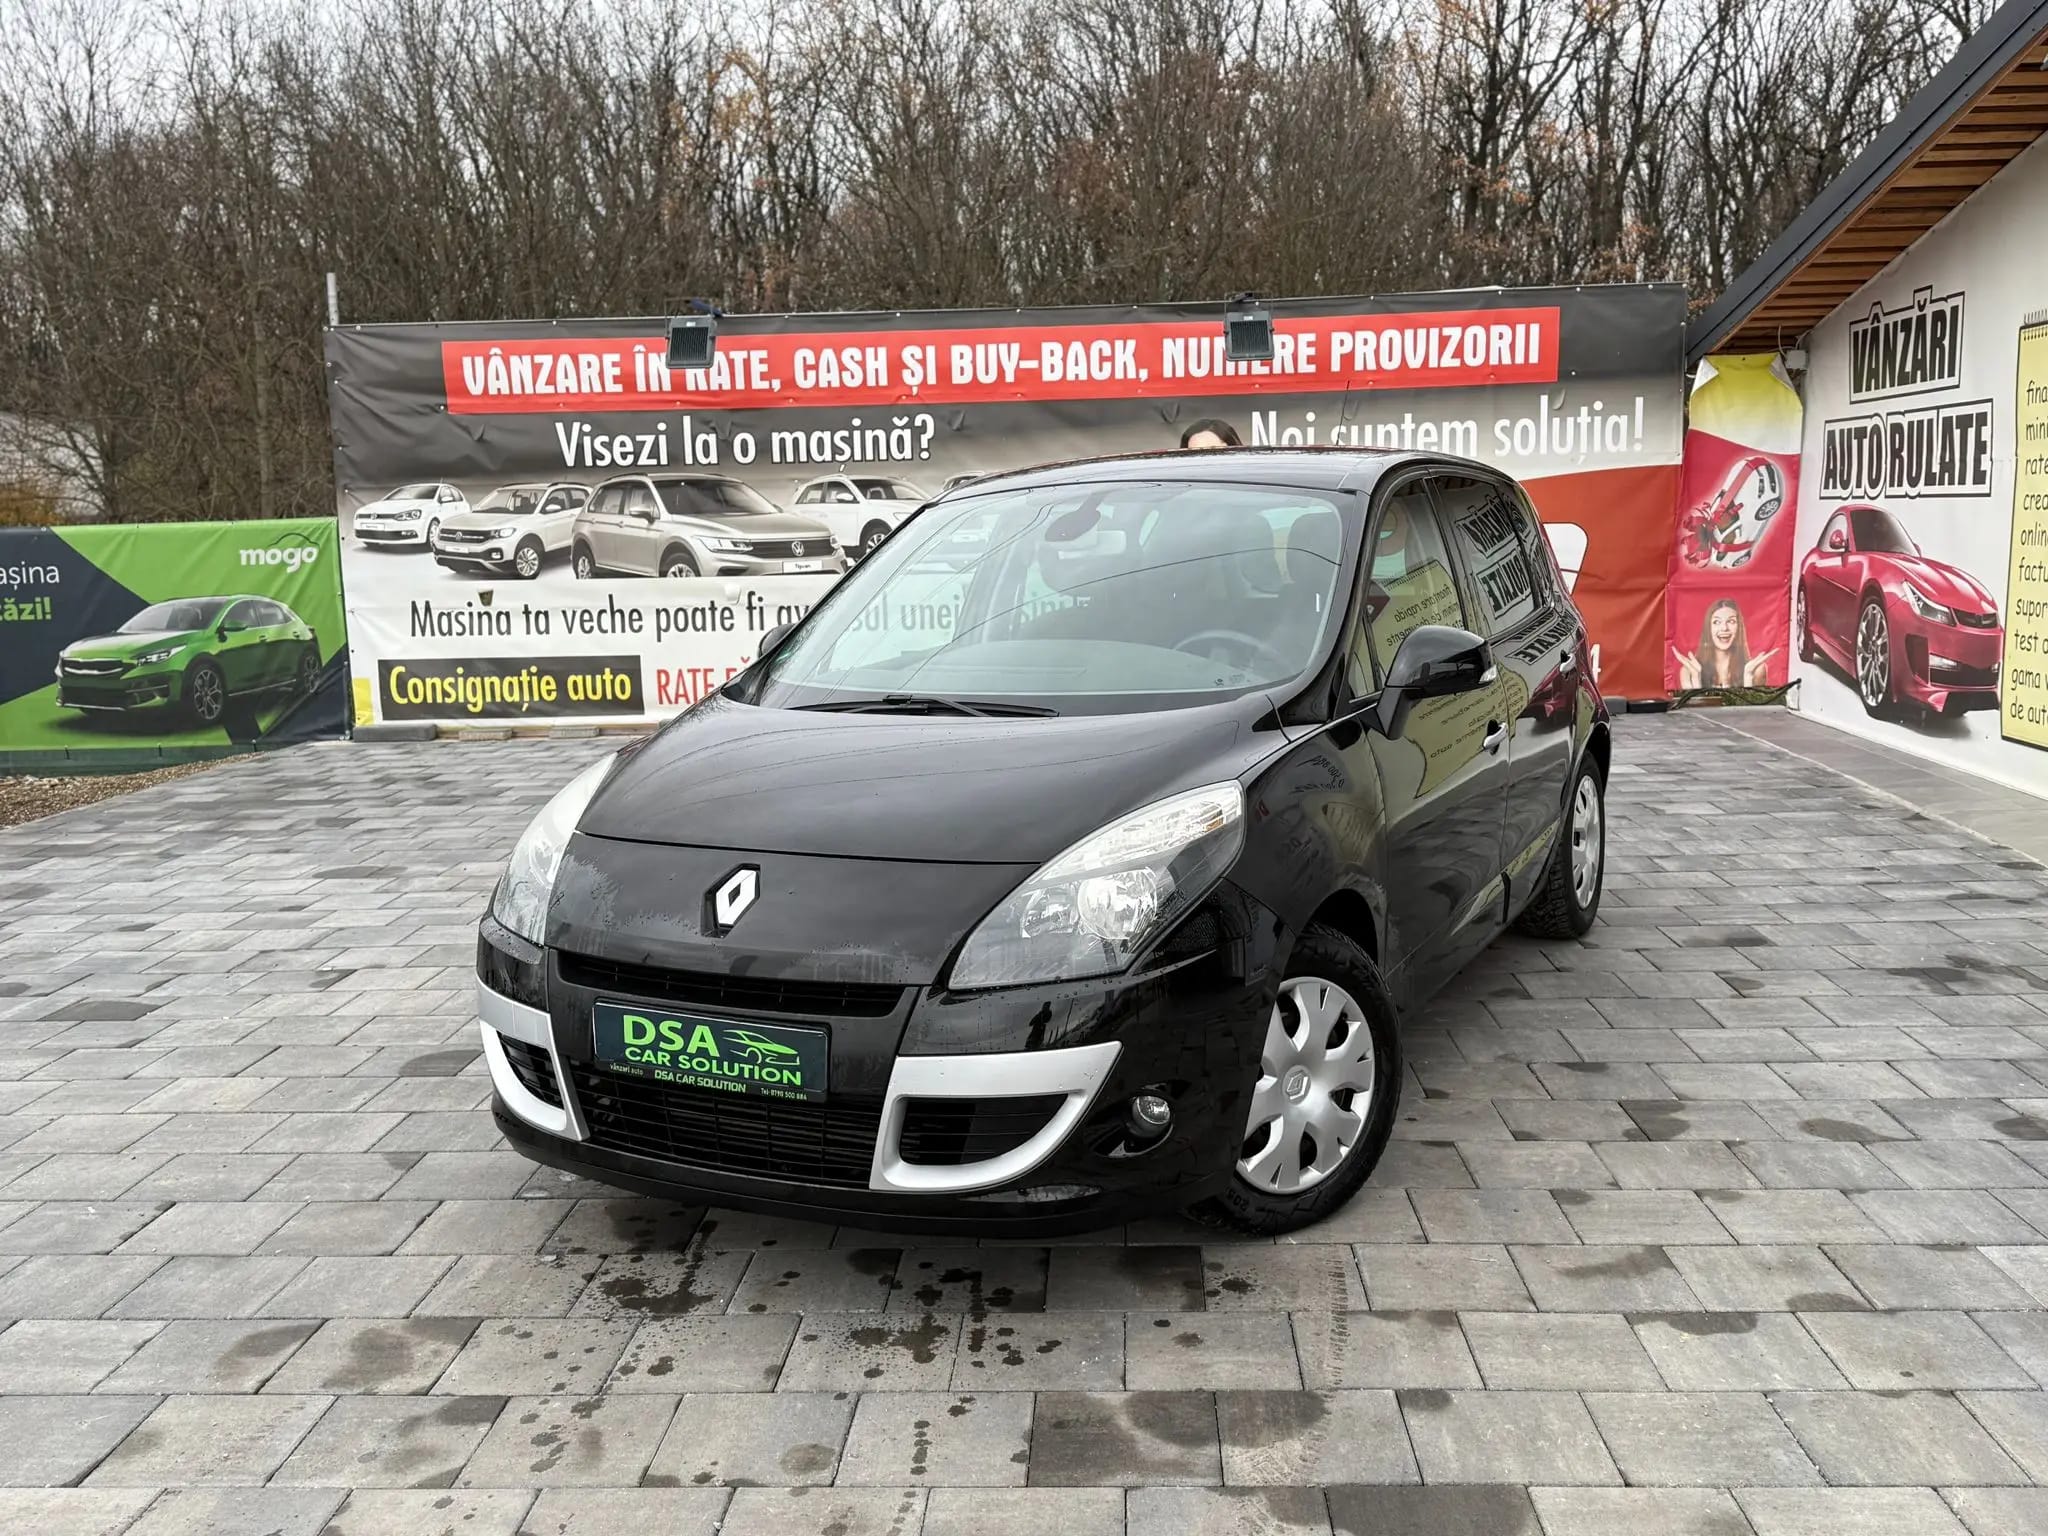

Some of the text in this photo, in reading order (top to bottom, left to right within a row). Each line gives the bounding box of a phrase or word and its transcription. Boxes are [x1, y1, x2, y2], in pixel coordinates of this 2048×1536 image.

[461, 346, 624, 396] VÂNZARE
[632, 343, 672, 393] ÎN
[793, 345, 889, 389] CASH
[900, 344, 937, 397] ȘI
[950, 338, 1149, 386] BUY-BACK,
[1330, 322, 1541, 373] PROVIZORII
[1852, 297, 1960, 395] VÂNZĂRI
[554, 413, 935, 472] Visezi la o mașină?
[1251, 394, 1644, 466] Noi suntem soluția!
[1823, 411, 1988, 491] AUTO RULATE
[239, 546, 319, 573] mogo
[521, 603, 550, 636] ta
[561, 593, 643, 635] veche
[655, 600, 735, 643] poate
[745, 590, 765, 632] fi
[2014, 628, 2039, 652] test
[389, 665, 632, 712] Consignație auto
[656, 667, 715, 705] RATE
[2011, 667, 2041, 691] gama
[2010, 695, 2048, 727] de aut
[623, 1014, 720, 1057] DSA
[625, 1047, 801, 1086] CAR SOLUTION
[654, 1069, 675, 1082] DSA
[675, 1073, 696, 1085] CAR
[696, 1077, 747, 1093] SOLUTION
